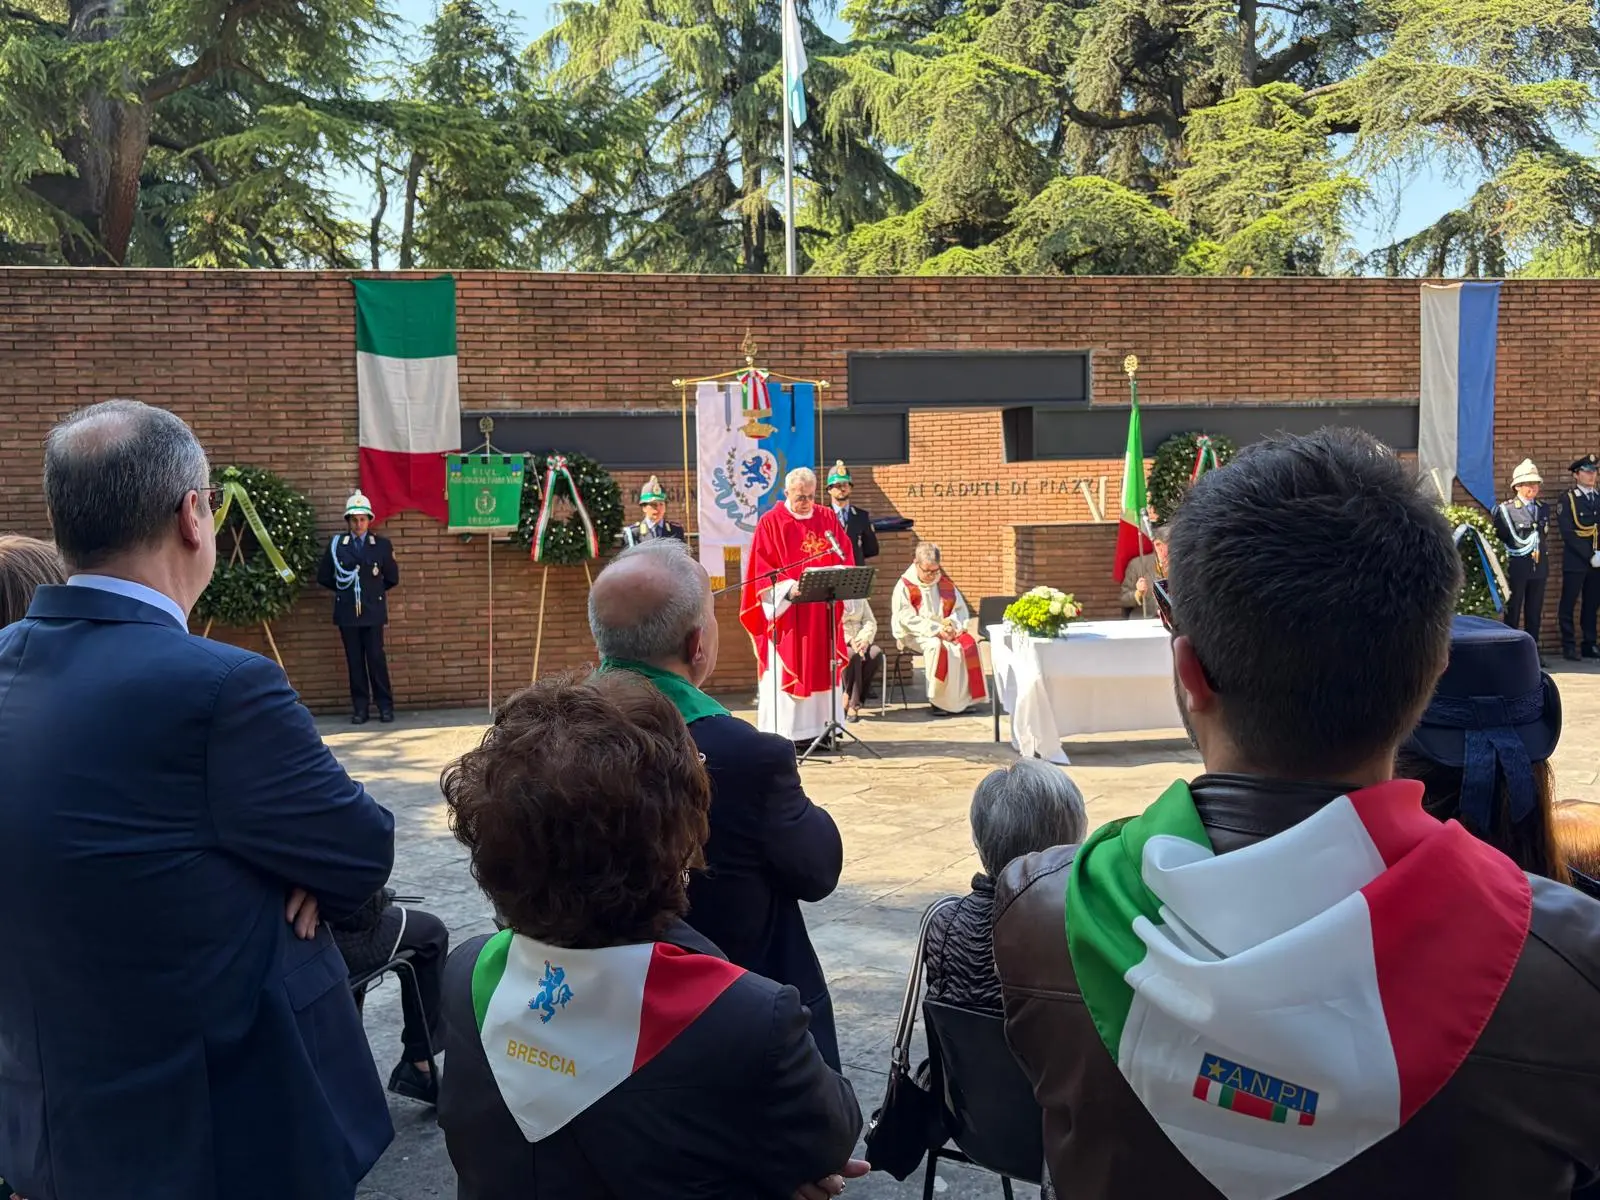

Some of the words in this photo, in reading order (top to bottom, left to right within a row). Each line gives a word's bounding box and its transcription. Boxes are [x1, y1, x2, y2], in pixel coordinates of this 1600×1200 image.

[907, 484, 925, 498] AI
[934, 482, 1001, 498] CADUTI
[1011, 480, 1030, 495] DI
[506, 1039, 576, 1078] BRESCIA
[1225, 1066, 1311, 1113] A.N.P.I.
